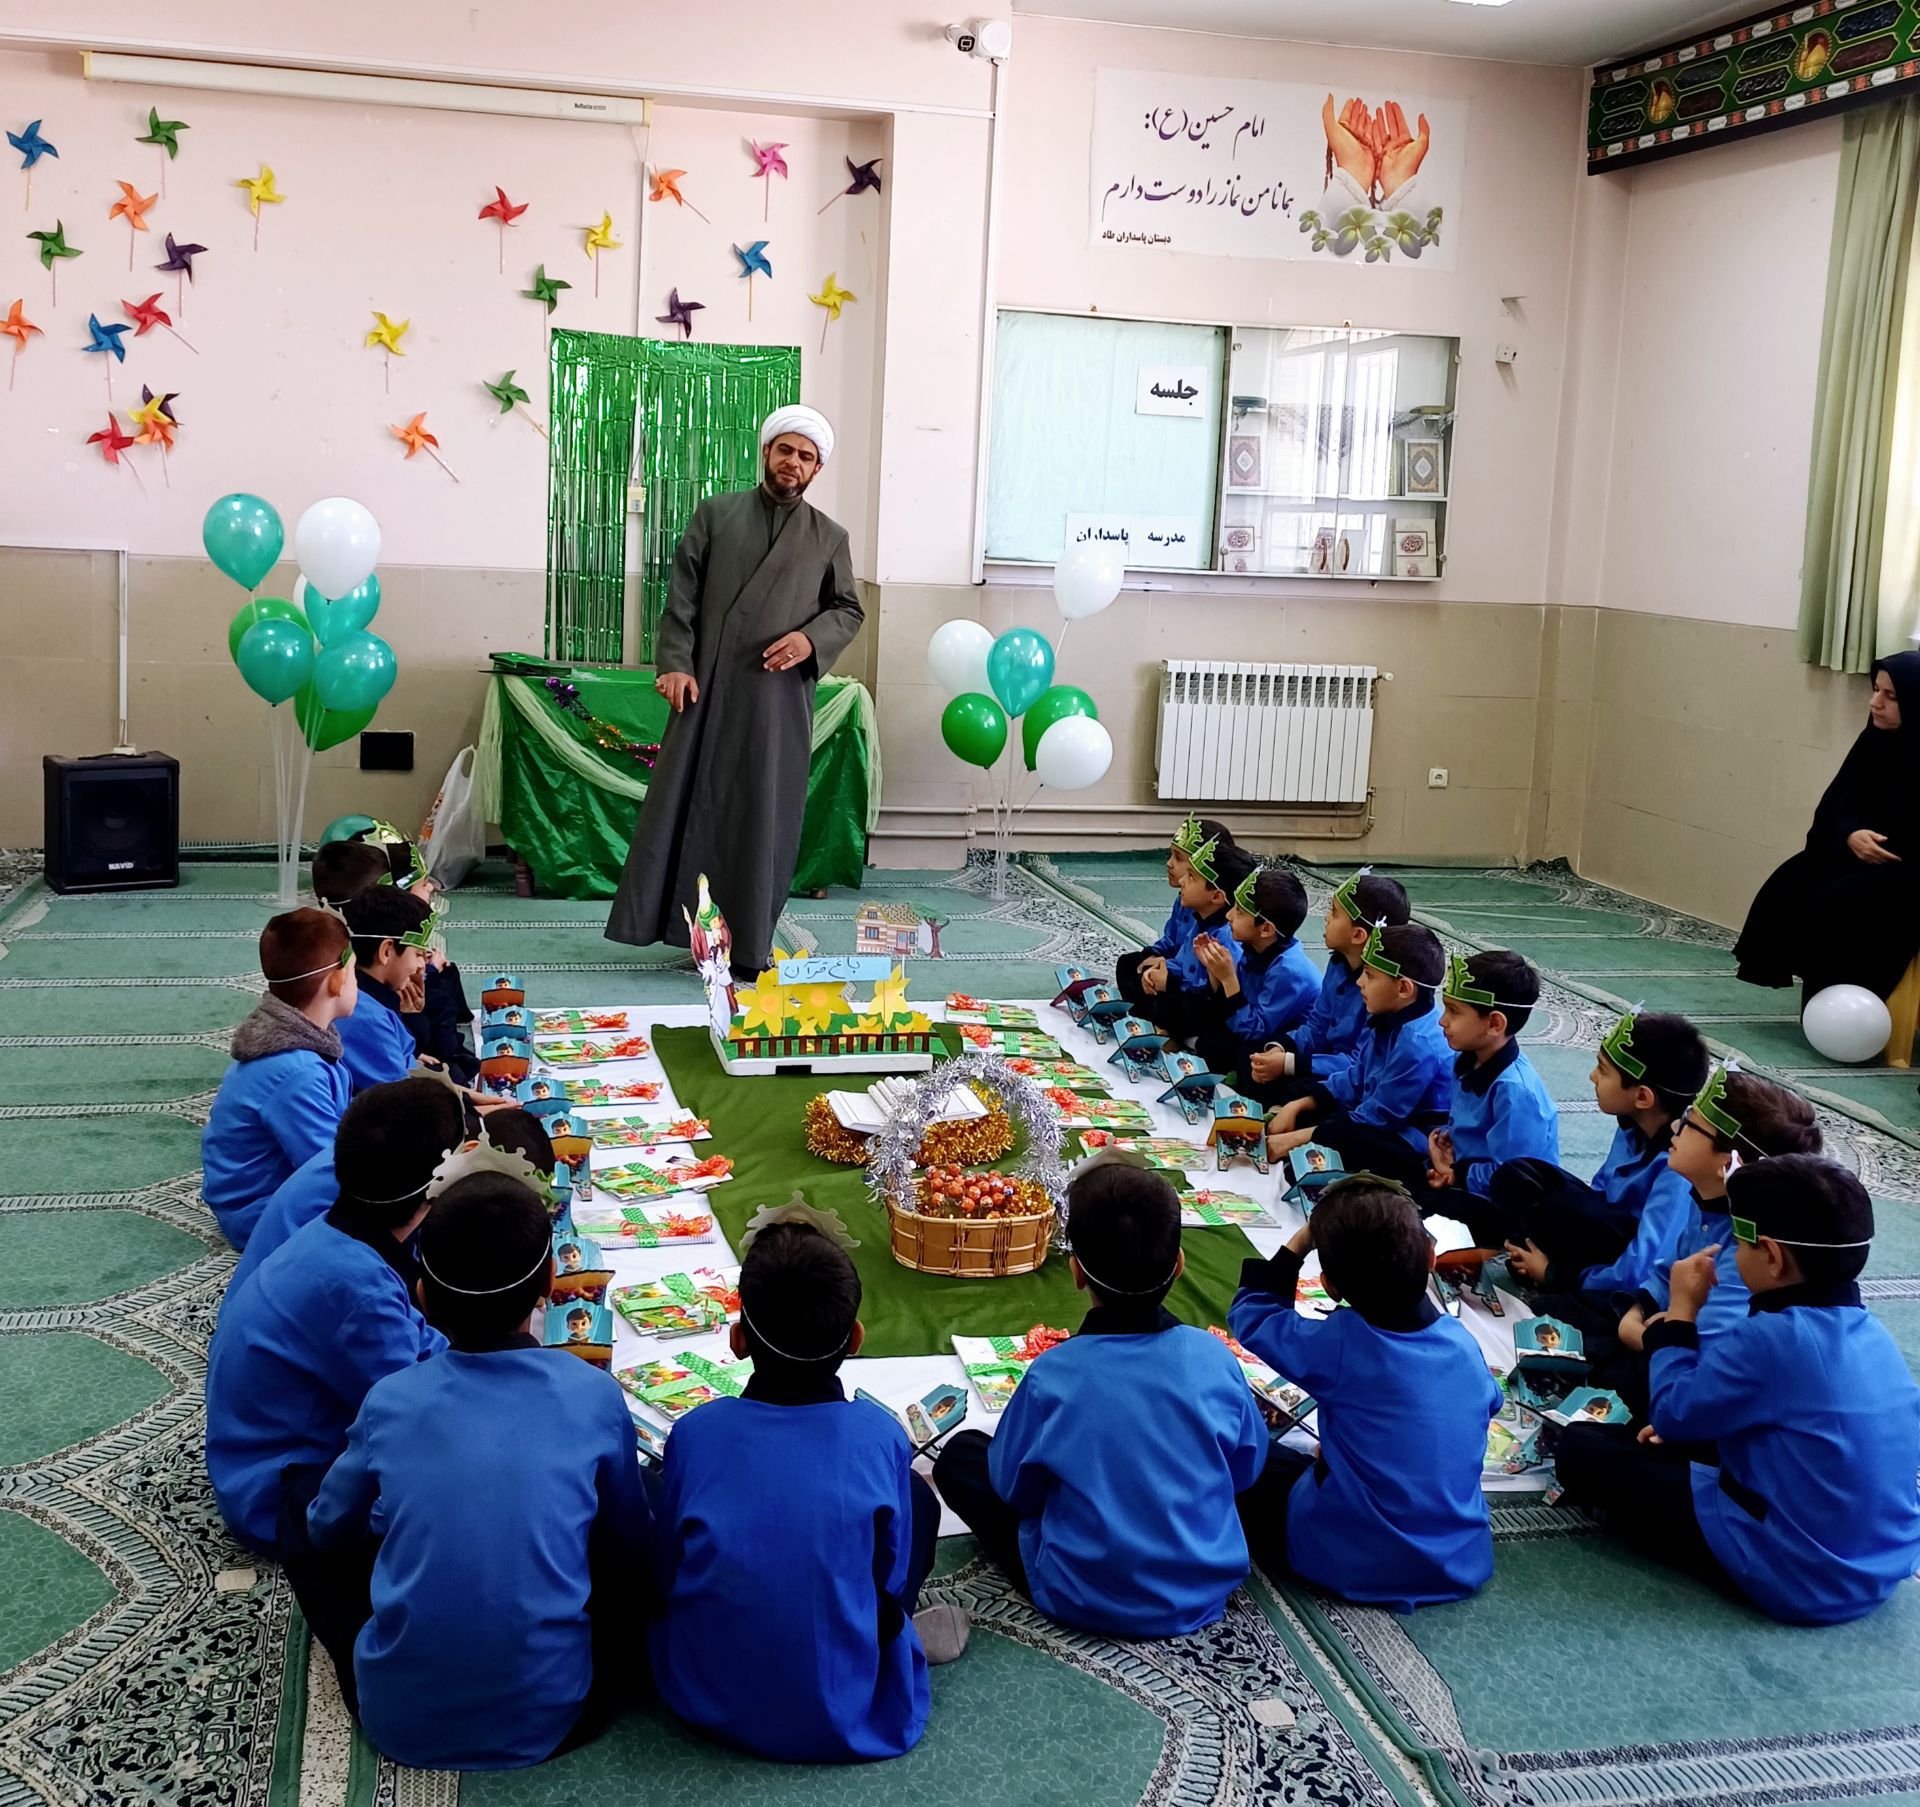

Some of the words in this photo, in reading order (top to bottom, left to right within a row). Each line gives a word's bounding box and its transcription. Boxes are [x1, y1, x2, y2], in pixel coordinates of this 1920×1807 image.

[1233, 114, 1265, 161] امام
[1101, 174, 1144, 222] دارم
[1144, 181, 1203, 205] دوست
[1206, 177, 1218, 205] را
[1218, 174, 1241, 207] نماز
[1241, 187, 1270, 217] من
[1271, 182, 1294, 218] همانا
[1116, 231, 1147, 245] پاسداران
[1147, 233, 1171, 245] دبستان
[1150, 378, 1199, 406] جلسه
[1147, 531, 1186, 546] مدرسه
[784, 961, 828, 979] قرآن
[828, 956, 860, 979] باغ
